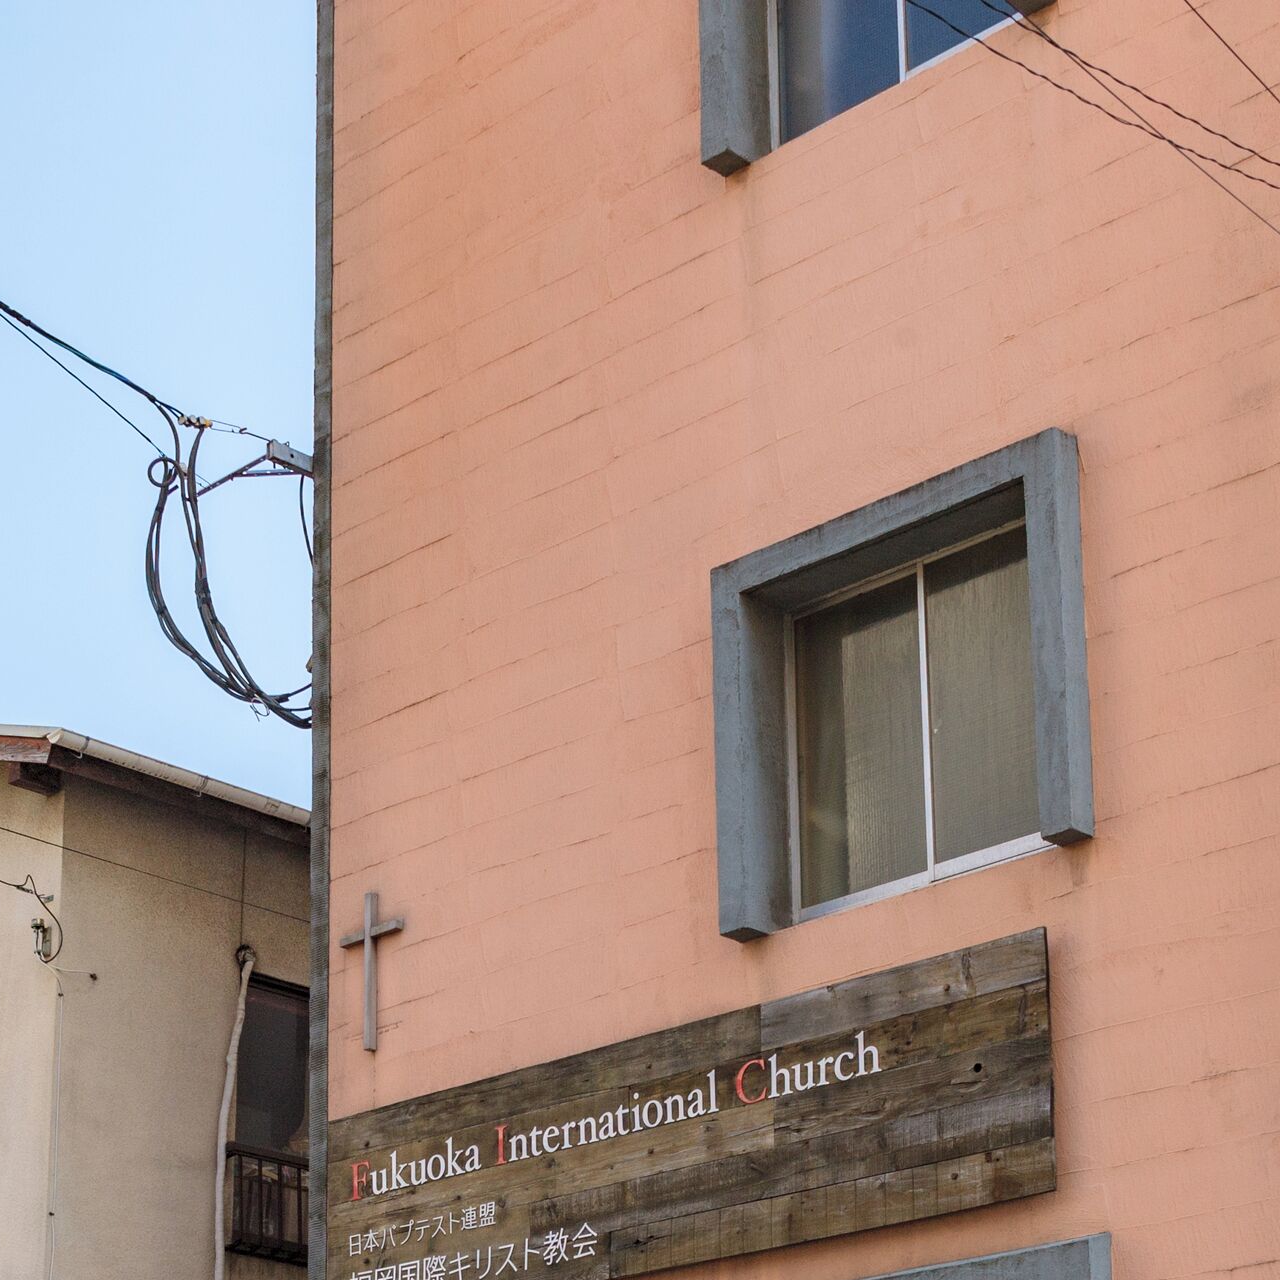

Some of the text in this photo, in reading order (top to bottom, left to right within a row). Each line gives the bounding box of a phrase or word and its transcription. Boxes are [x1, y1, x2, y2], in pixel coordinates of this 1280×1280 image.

[351, 1031, 881, 1200] Fukuoka International Church
[349, 1201, 496, 1257] 日本バプテスト連盟
